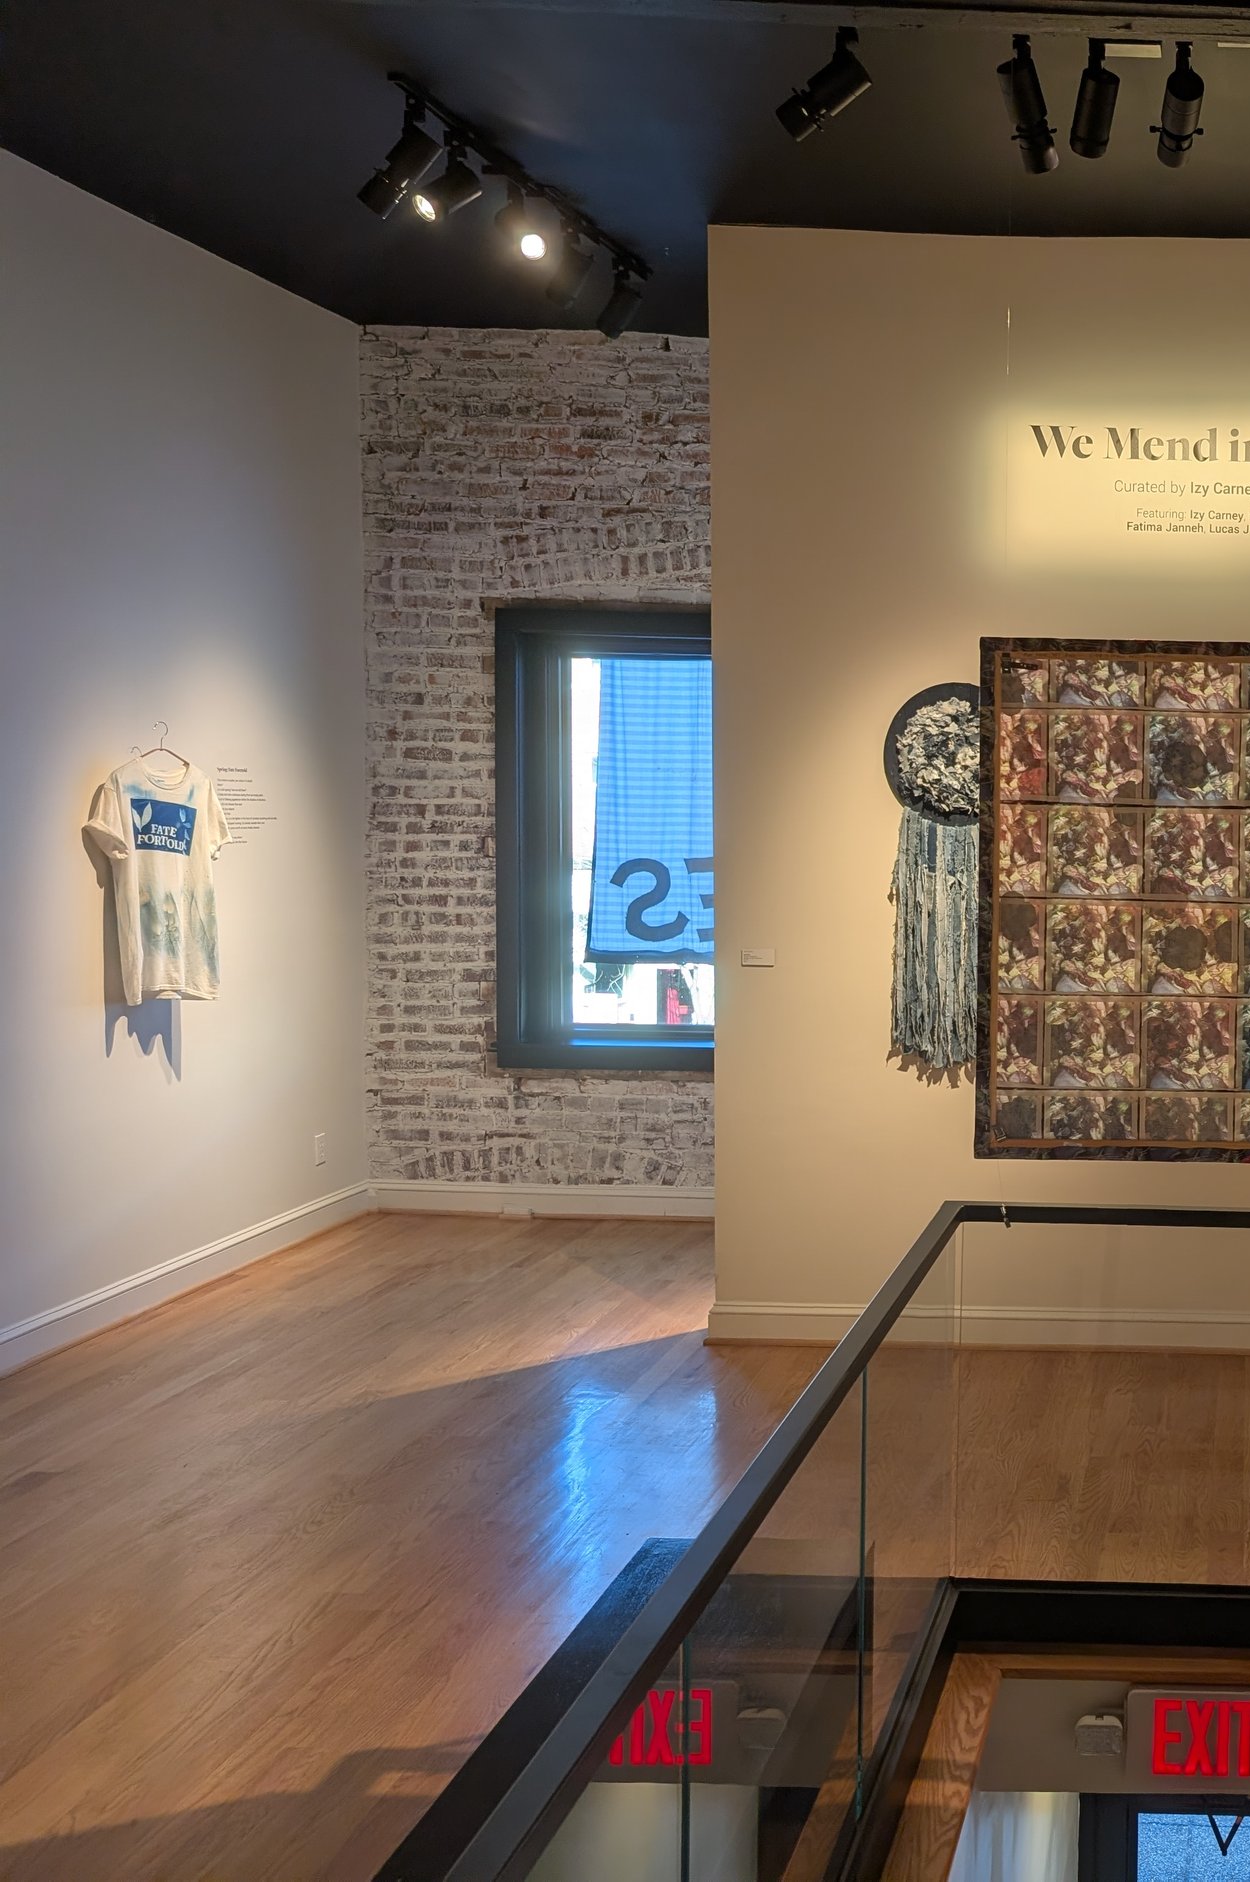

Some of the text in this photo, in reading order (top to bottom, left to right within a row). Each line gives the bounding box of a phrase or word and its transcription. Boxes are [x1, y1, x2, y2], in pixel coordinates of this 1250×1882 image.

[1028, 424, 1094, 459] We
[1103, 427, 1219, 462] Mend
[1114, 479, 1166, 493] Curated
[1170, 480, 1186, 497] by
[1190, 481, 1209, 498] Izy
[1136, 507, 1187, 521] Featuring:
[1190, 509, 1205, 521] Izy
[1208, 510, 1246, 523] Carney,
[1126, 521, 1163, 532] Fatima
[1166, 522, 1206, 534] Janneh,
[1209, 524, 1240, 534] Lucas
[1243, 525, 1249, 535] J
[151, 823, 178, 838] FATE
[137, 834, 184, 851] FORTOLD
